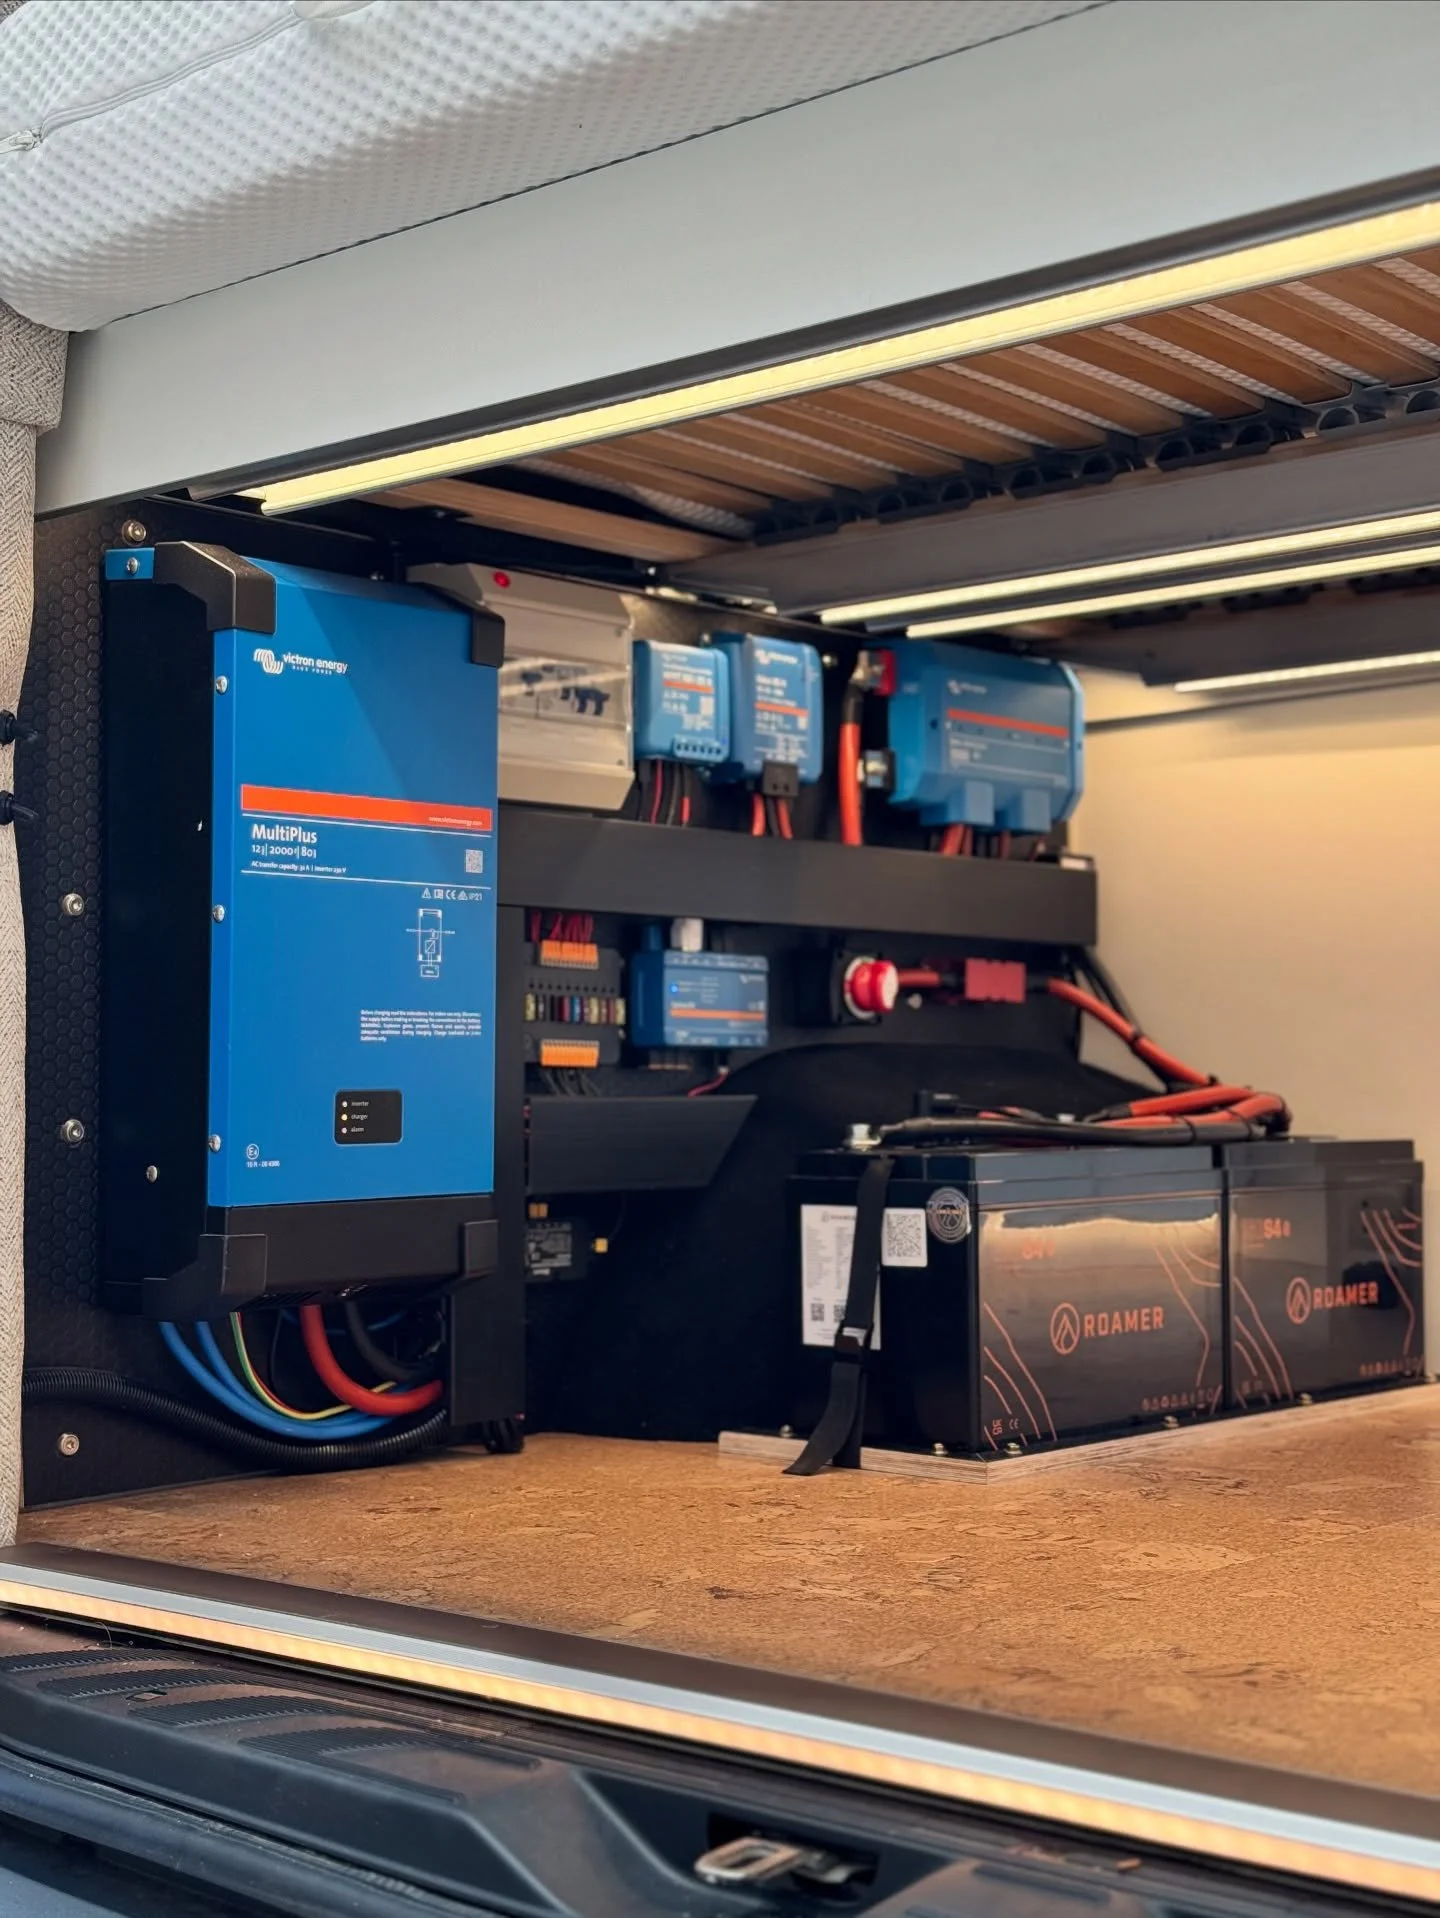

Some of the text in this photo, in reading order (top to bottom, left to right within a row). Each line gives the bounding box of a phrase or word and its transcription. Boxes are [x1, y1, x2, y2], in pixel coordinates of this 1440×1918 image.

[282, 652, 348, 674] victron energy
[252, 823, 318, 844] MultiPlus
[1312, 1281, 1378, 1310] ROAMER
[1084, 1306, 1164, 1338] ROAMER
